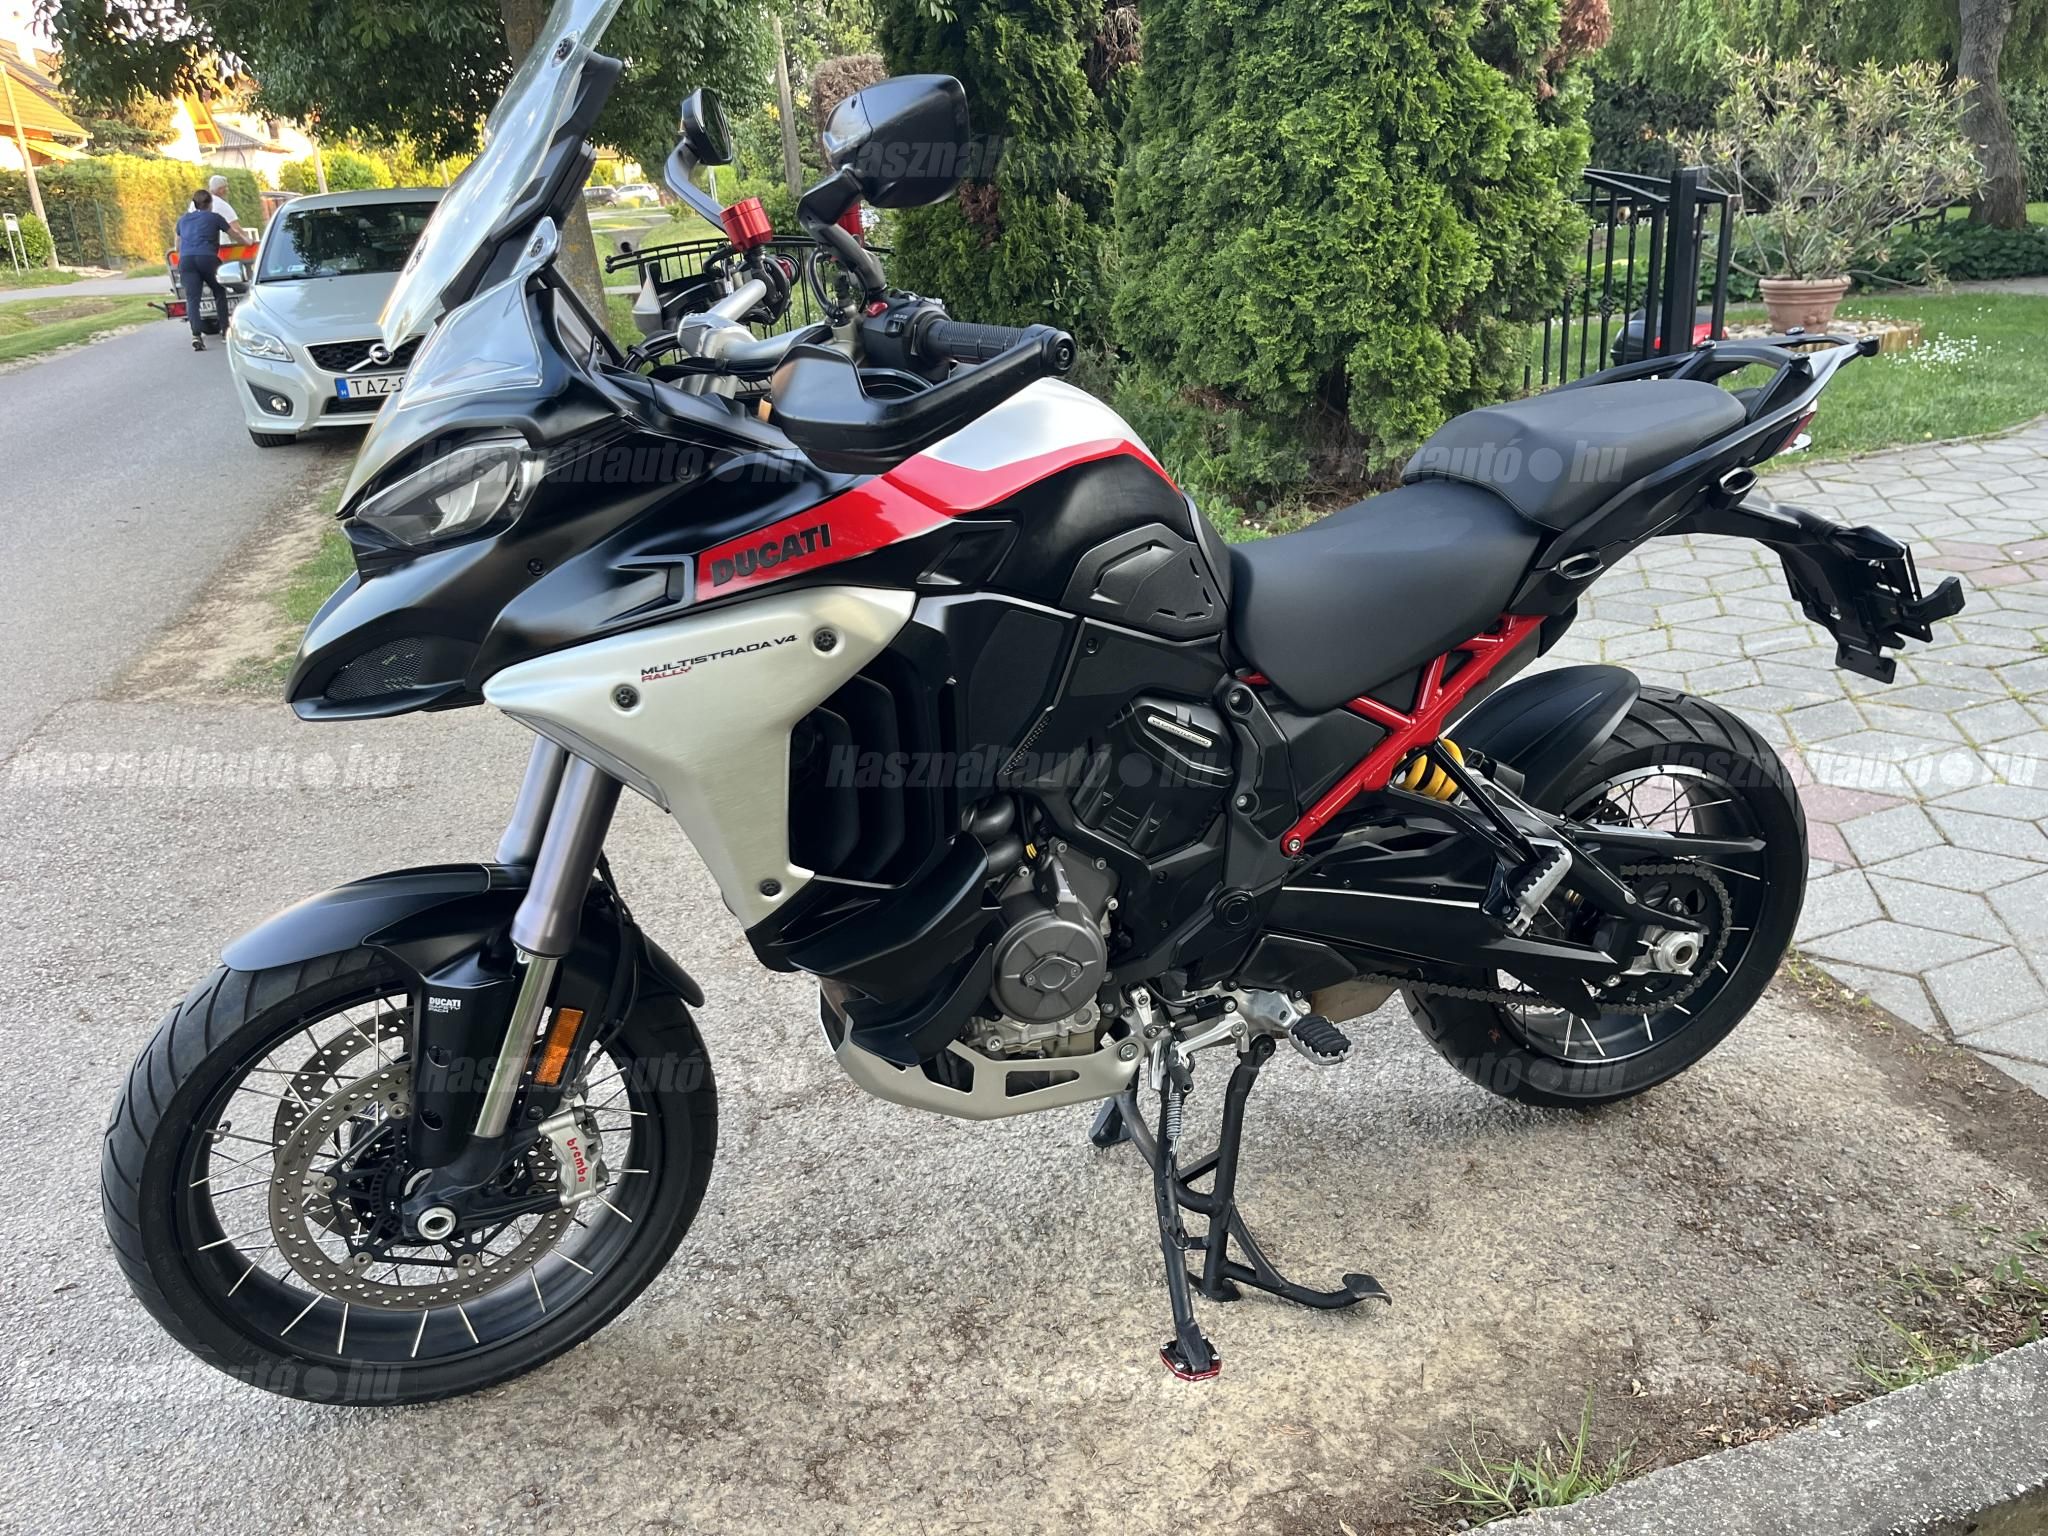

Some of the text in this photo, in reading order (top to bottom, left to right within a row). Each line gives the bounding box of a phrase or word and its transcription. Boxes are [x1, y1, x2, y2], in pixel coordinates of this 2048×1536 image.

[711, 522, 832, 588] DUCATI
[640, 634, 798, 676] MULTISTRADA V4
[641, 666, 692, 682] RALLY
[429, 996, 461, 1007] DUCATI
[566, 1137, 588, 1182] brembo
